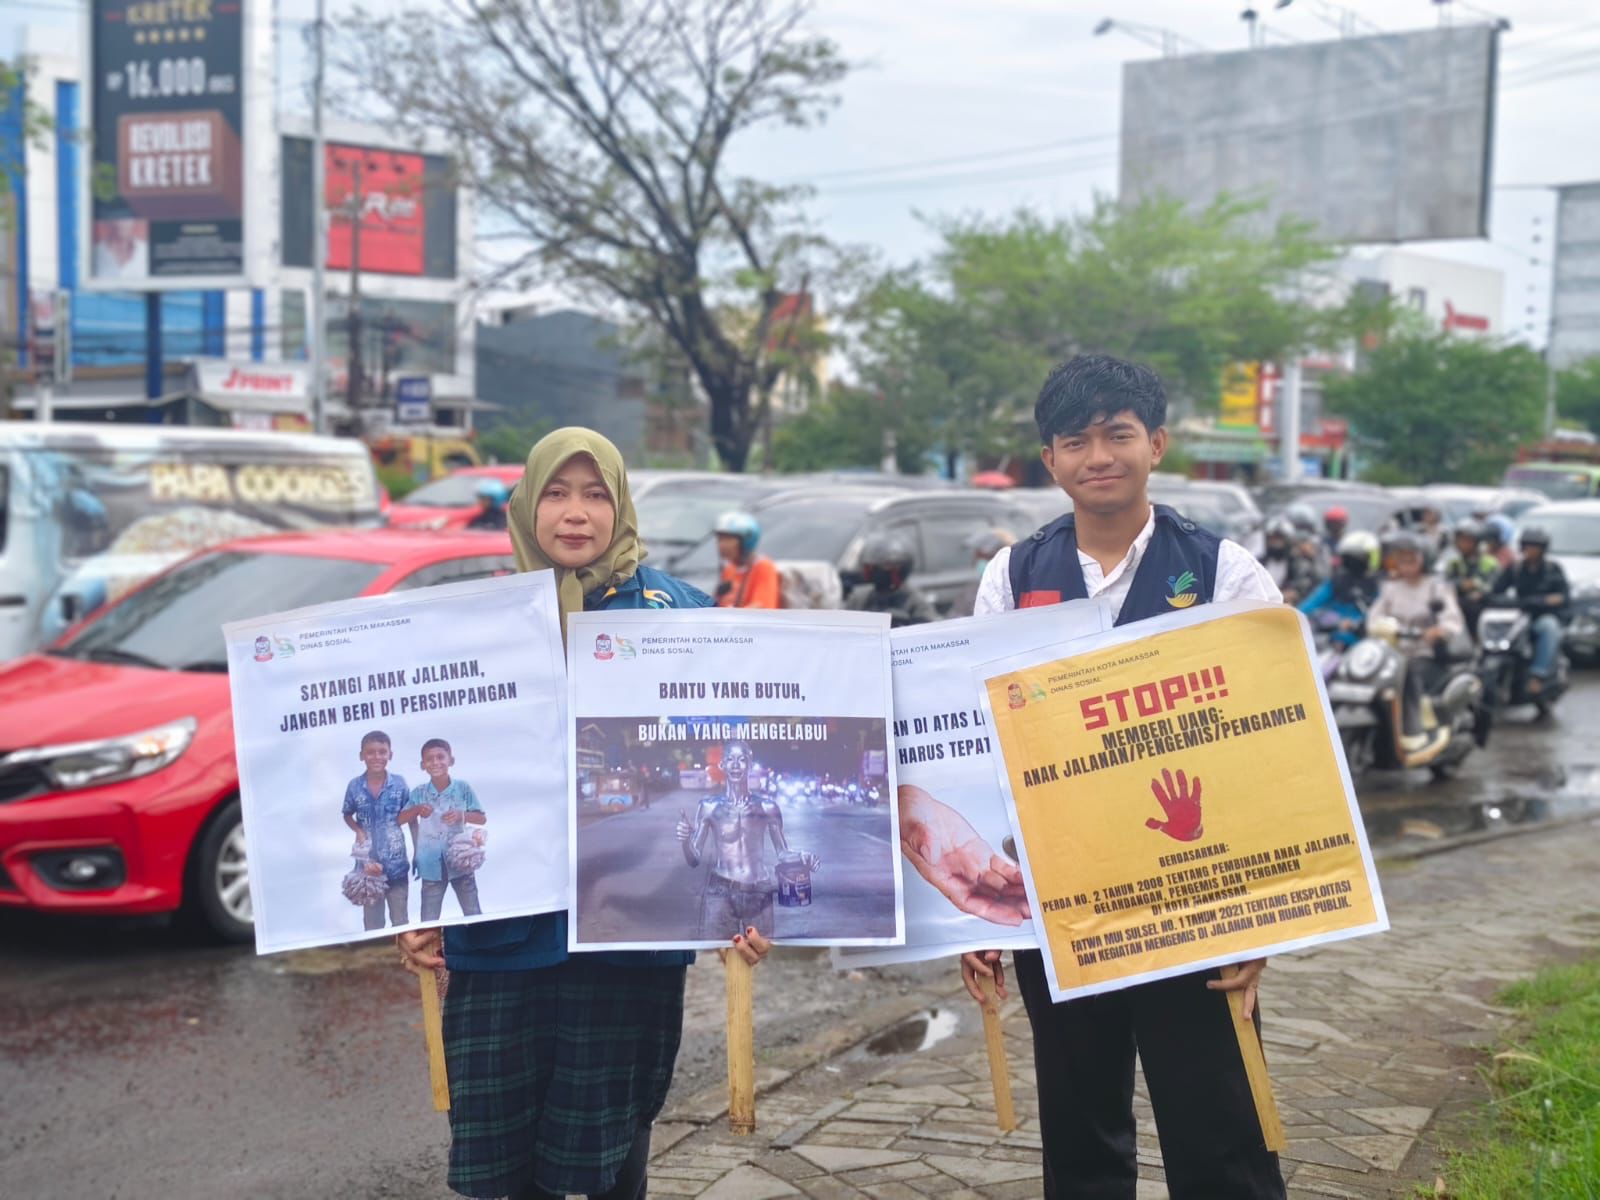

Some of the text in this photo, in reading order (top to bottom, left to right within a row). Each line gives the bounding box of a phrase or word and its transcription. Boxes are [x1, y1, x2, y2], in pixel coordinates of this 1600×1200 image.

[126, 58, 206, 98] 16.000
[130, 155, 211, 186] KRETEK
[299, 618, 411, 640] PEMERINTAH KOTA MAKASSAR
[300, 637, 352, 651] DINAS SOSIAL
[641, 637, 691, 645] PEMERINTAH
[642, 647, 665, 655] DINAS
[910, 645, 929, 654] KOTA
[930, 639, 970, 651] MAKASSAR
[300, 659, 485, 702] SAYANGI ANAK JALANAN,
[1048, 649, 1160, 684] PEMERINTAH KOTA MAKASSAR
[659, 682, 806, 701] BANTU YANG BUTUH,
[1051, 677, 1102, 694] DINAS SOSIAL
[1079, 665, 1229, 731] STOP!!!
[280, 681, 517, 732] JANGAN BERI DI PERSIMPANGAN
[638, 723, 827, 741] BUKAN YANG MENGELABUI
[913, 717, 928, 734] DI
[933, 711, 968, 732] ATAS
[1102, 706, 1226, 750] MEMBERI UANG:
[898, 737, 991, 765] HARUS TEPAT
[1023, 703, 1307, 788] ANAK JALANAN/PENGEMIS/PENGAMEN
[1159, 842, 1230, 868] BERDASARKAN:
[1042, 897, 1072, 913] PERDA
[1073, 893, 1092, 906] NO.
[1093, 890, 1101, 902] 2
[1103, 882, 1135, 899] TAHUN
[1137, 876, 1164, 891] 2008
[1166, 866, 1210, 885] TENTANG
[1211, 851, 1271, 875] PEMBINAAN
[1274, 844, 1302, 860] ANAK
[1094, 859, 1301, 915] GELANDANGAN, PENGEMIS DAN PENGAMEN
[1071, 879, 1352, 952] FATWA MUI SULSEL NO. 1 TAHUN 2021 TENTANG EKSPLOITASI
[1152, 885, 1251, 916] DI KOTA MAKASSAR.
[1077, 896, 1352, 967] DAN KEGIATAN MENGEMIS DI JALANAN DAN RUANG PUBLIK.
